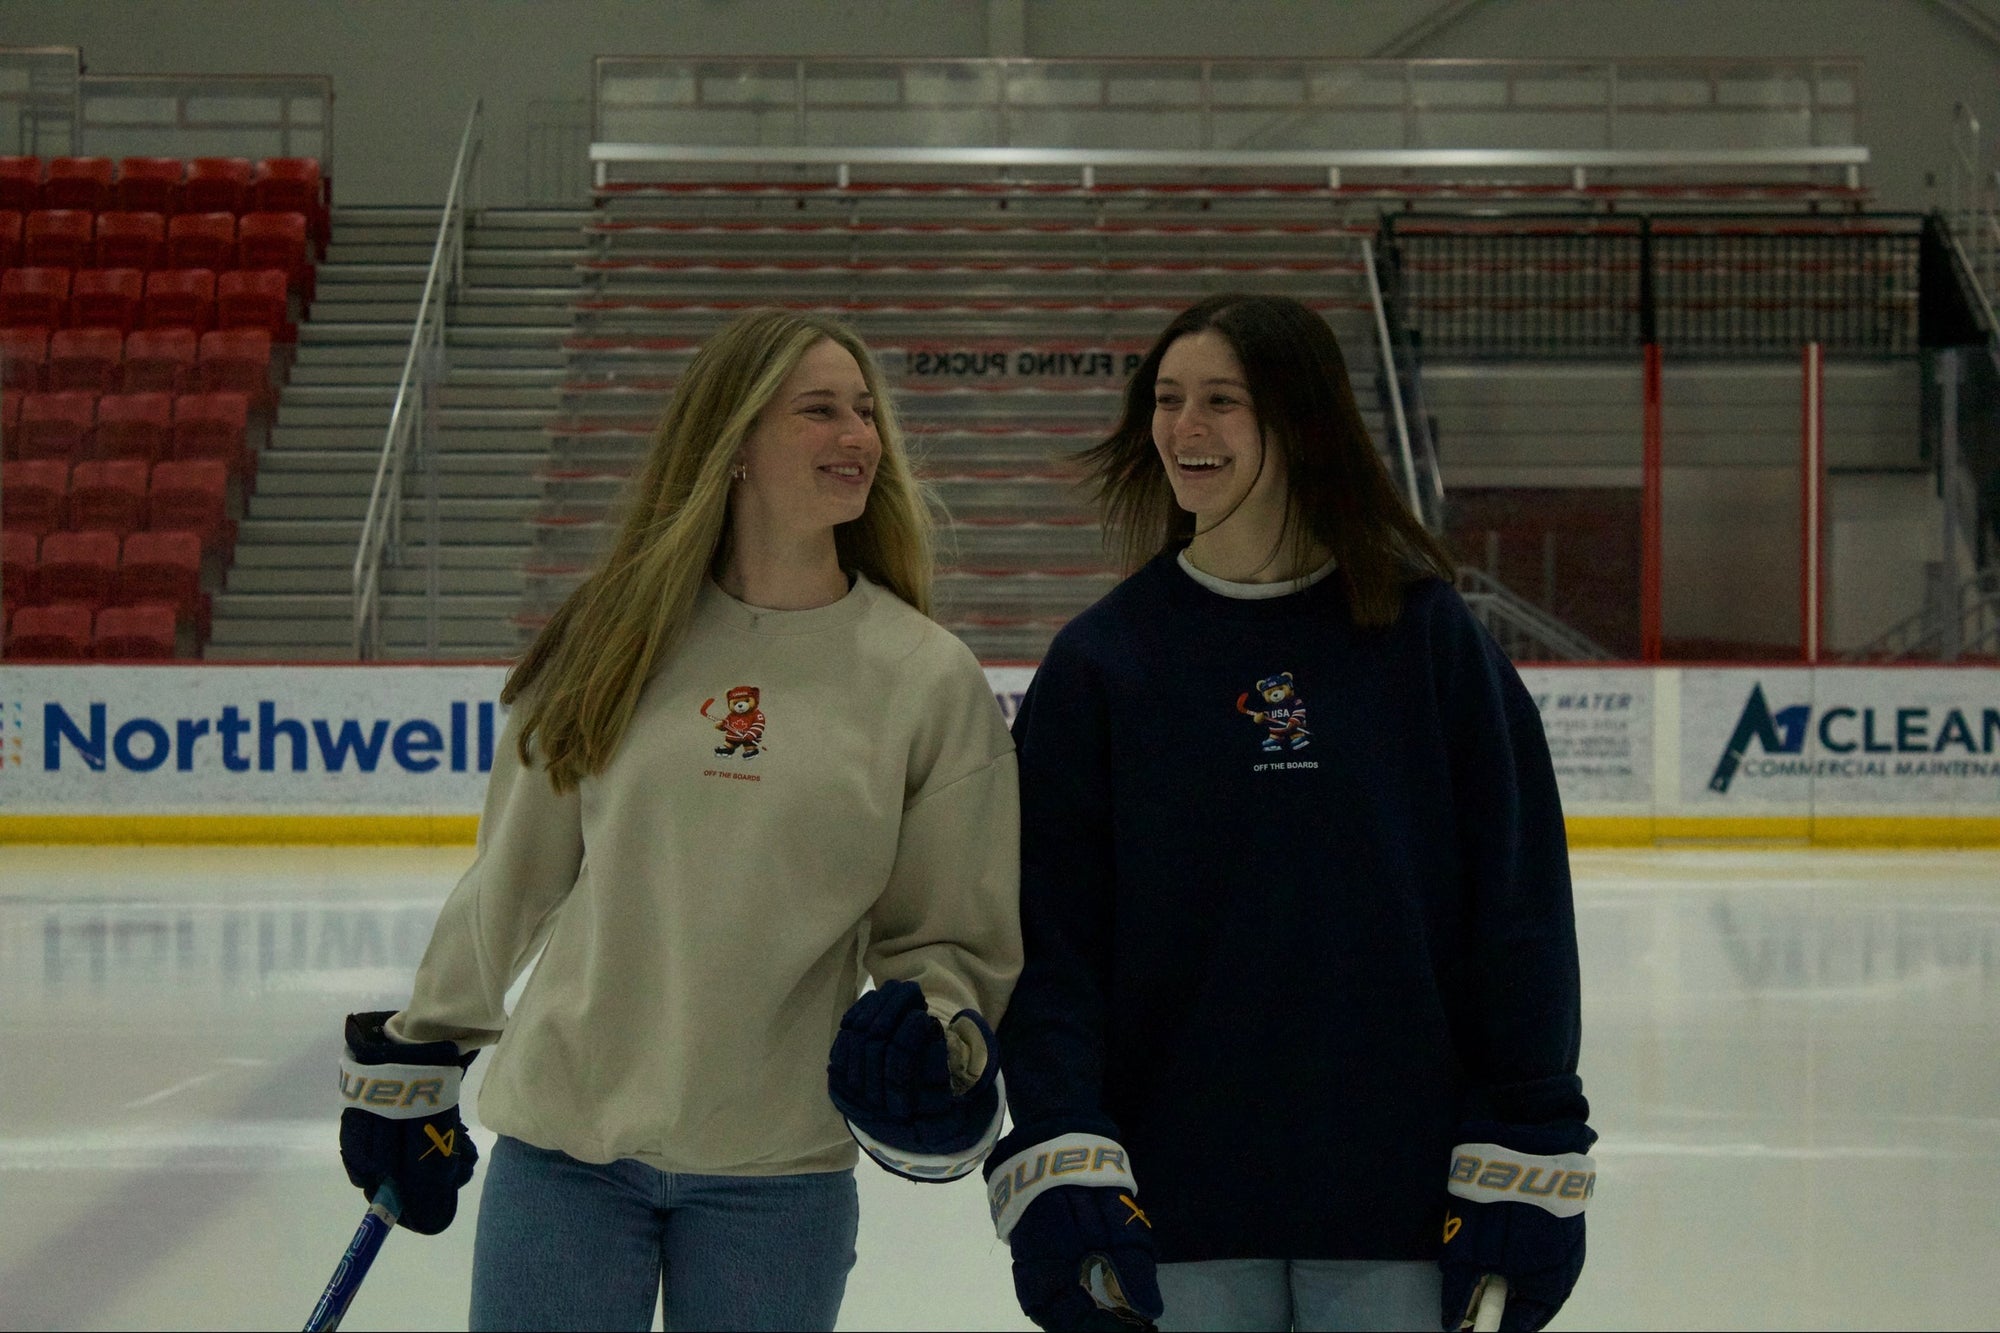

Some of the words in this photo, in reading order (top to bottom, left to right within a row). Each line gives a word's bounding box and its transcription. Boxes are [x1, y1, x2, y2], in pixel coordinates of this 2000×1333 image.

[1271, 708, 1290, 719] USA
[44, 701, 494, 772] Northwell
[1253, 764, 1269, 772] OFF
[1270, 762, 1285, 770] THE
[1286, 761, 1319, 769] BOARDS
[1744, 760, 1886, 777] COMMERCIAL
[733, 773, 760, 781] BOARDS
